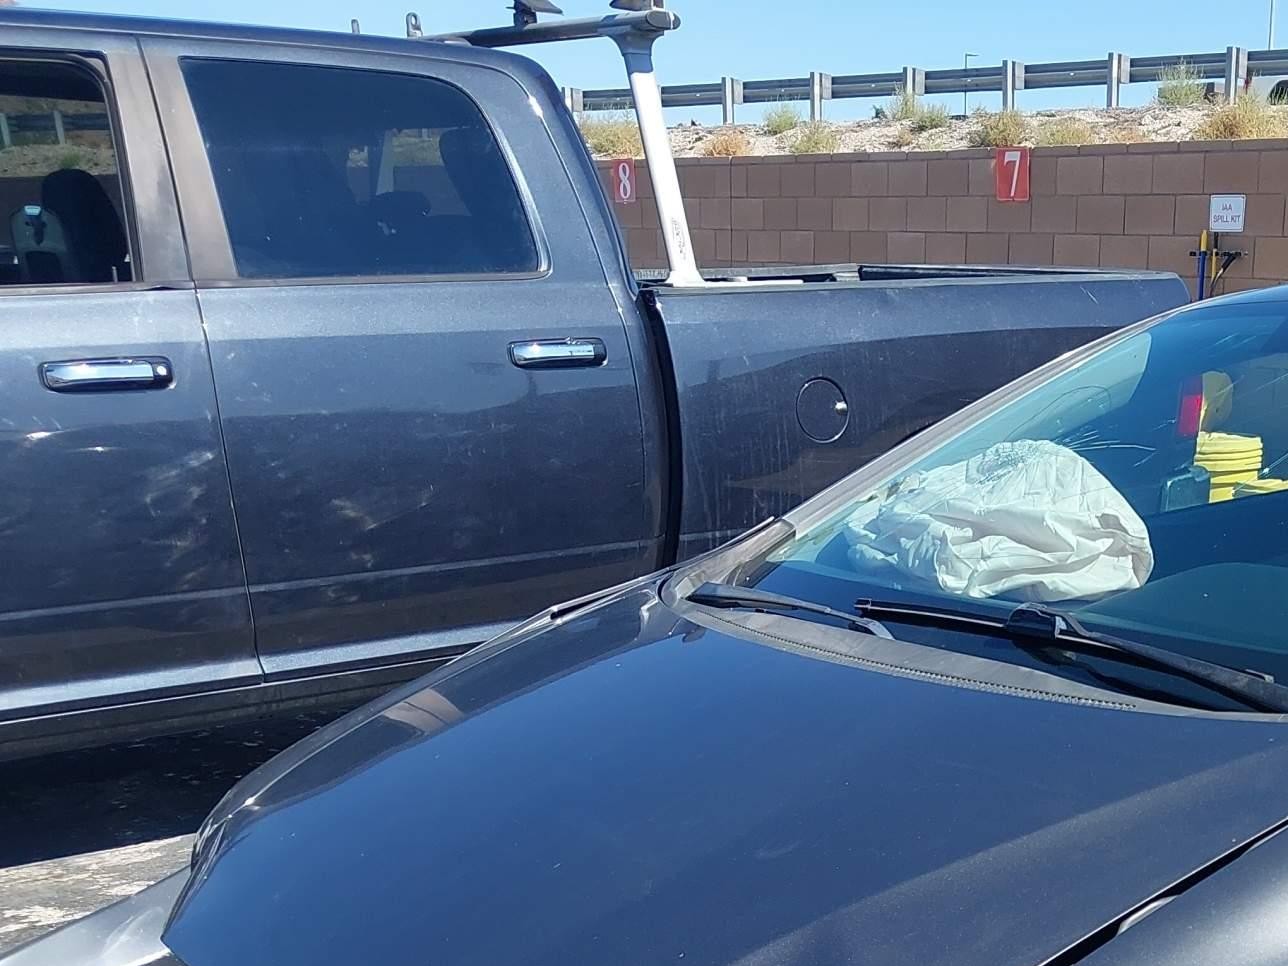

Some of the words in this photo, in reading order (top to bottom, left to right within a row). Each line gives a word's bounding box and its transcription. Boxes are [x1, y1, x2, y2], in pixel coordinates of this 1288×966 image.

[618, 162, 631, 199] 8
[1003, 150, 1021, 197] 7
[1213, 214, 1229, 222] SPILL
[1231, 214, 1240, 222] KIT
[1221, 203, 1232, 211] IAA
